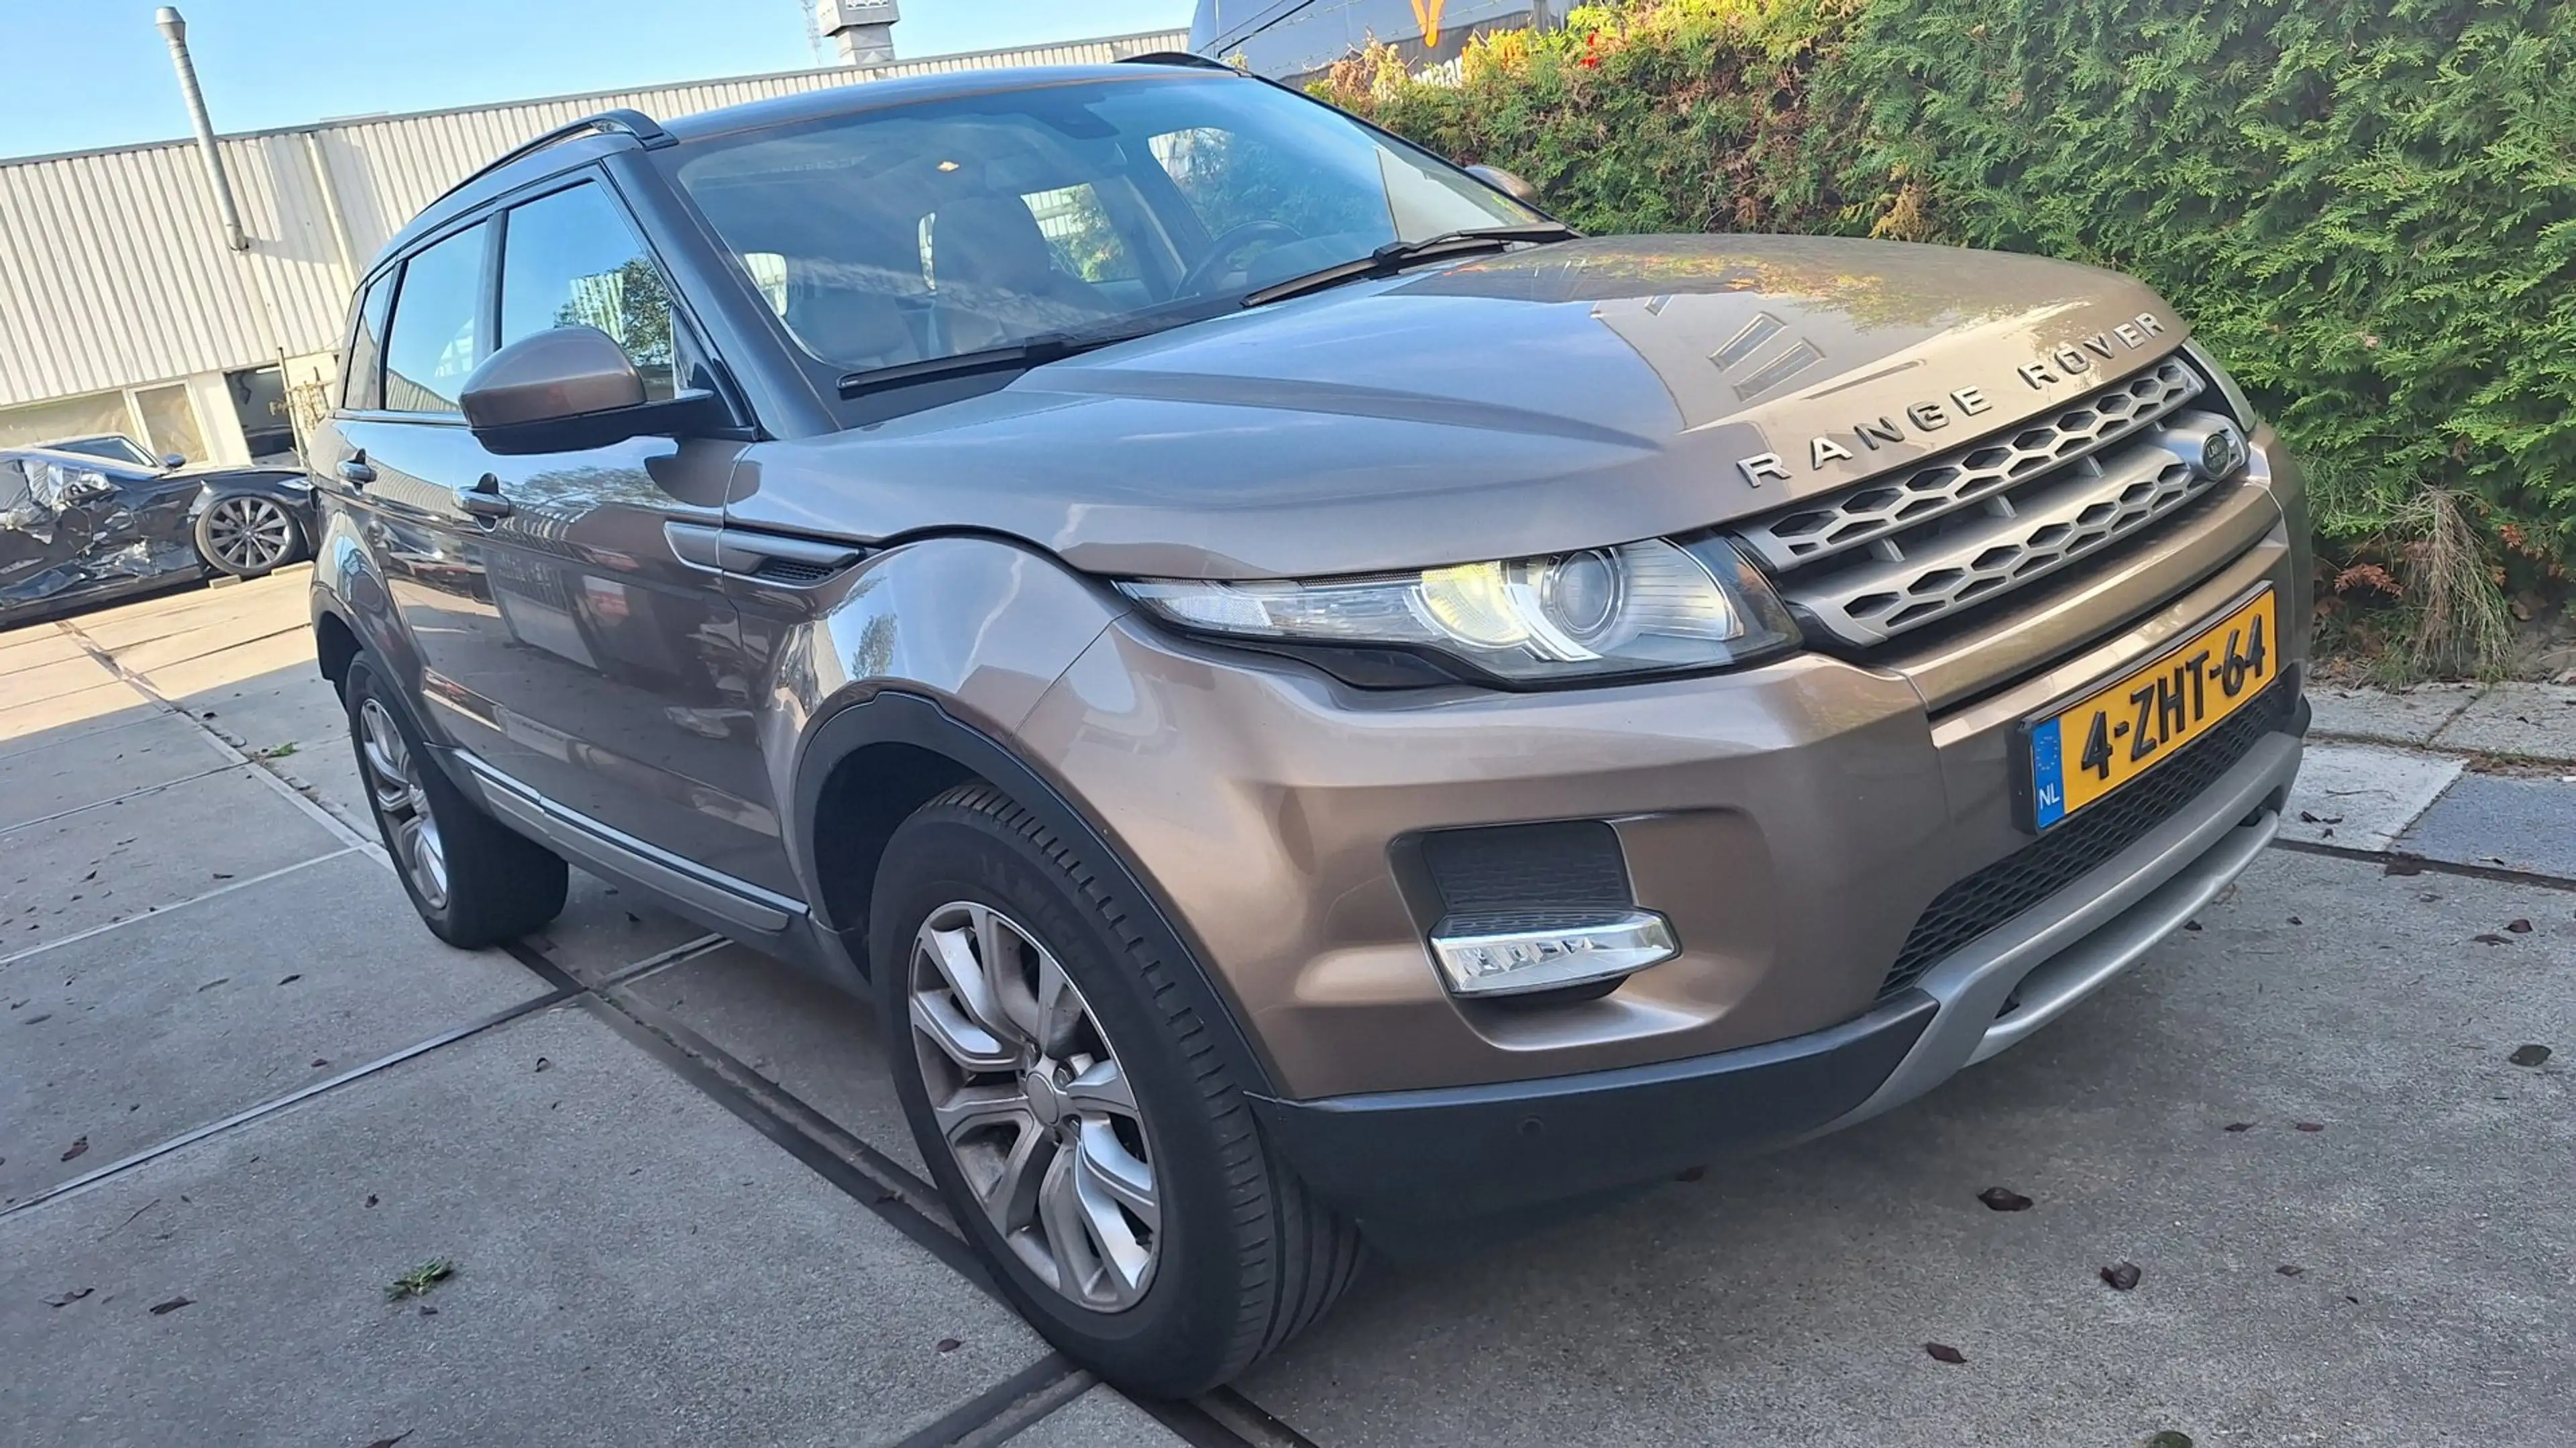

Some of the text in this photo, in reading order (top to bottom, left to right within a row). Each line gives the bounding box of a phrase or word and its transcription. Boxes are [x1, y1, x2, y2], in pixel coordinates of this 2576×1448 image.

[1736, 312, 2165, 488] RANGE ROVER
[2081, 613, 2265, 780] 4-ZHT-64
[2039, 783, 2060, 810] NL
